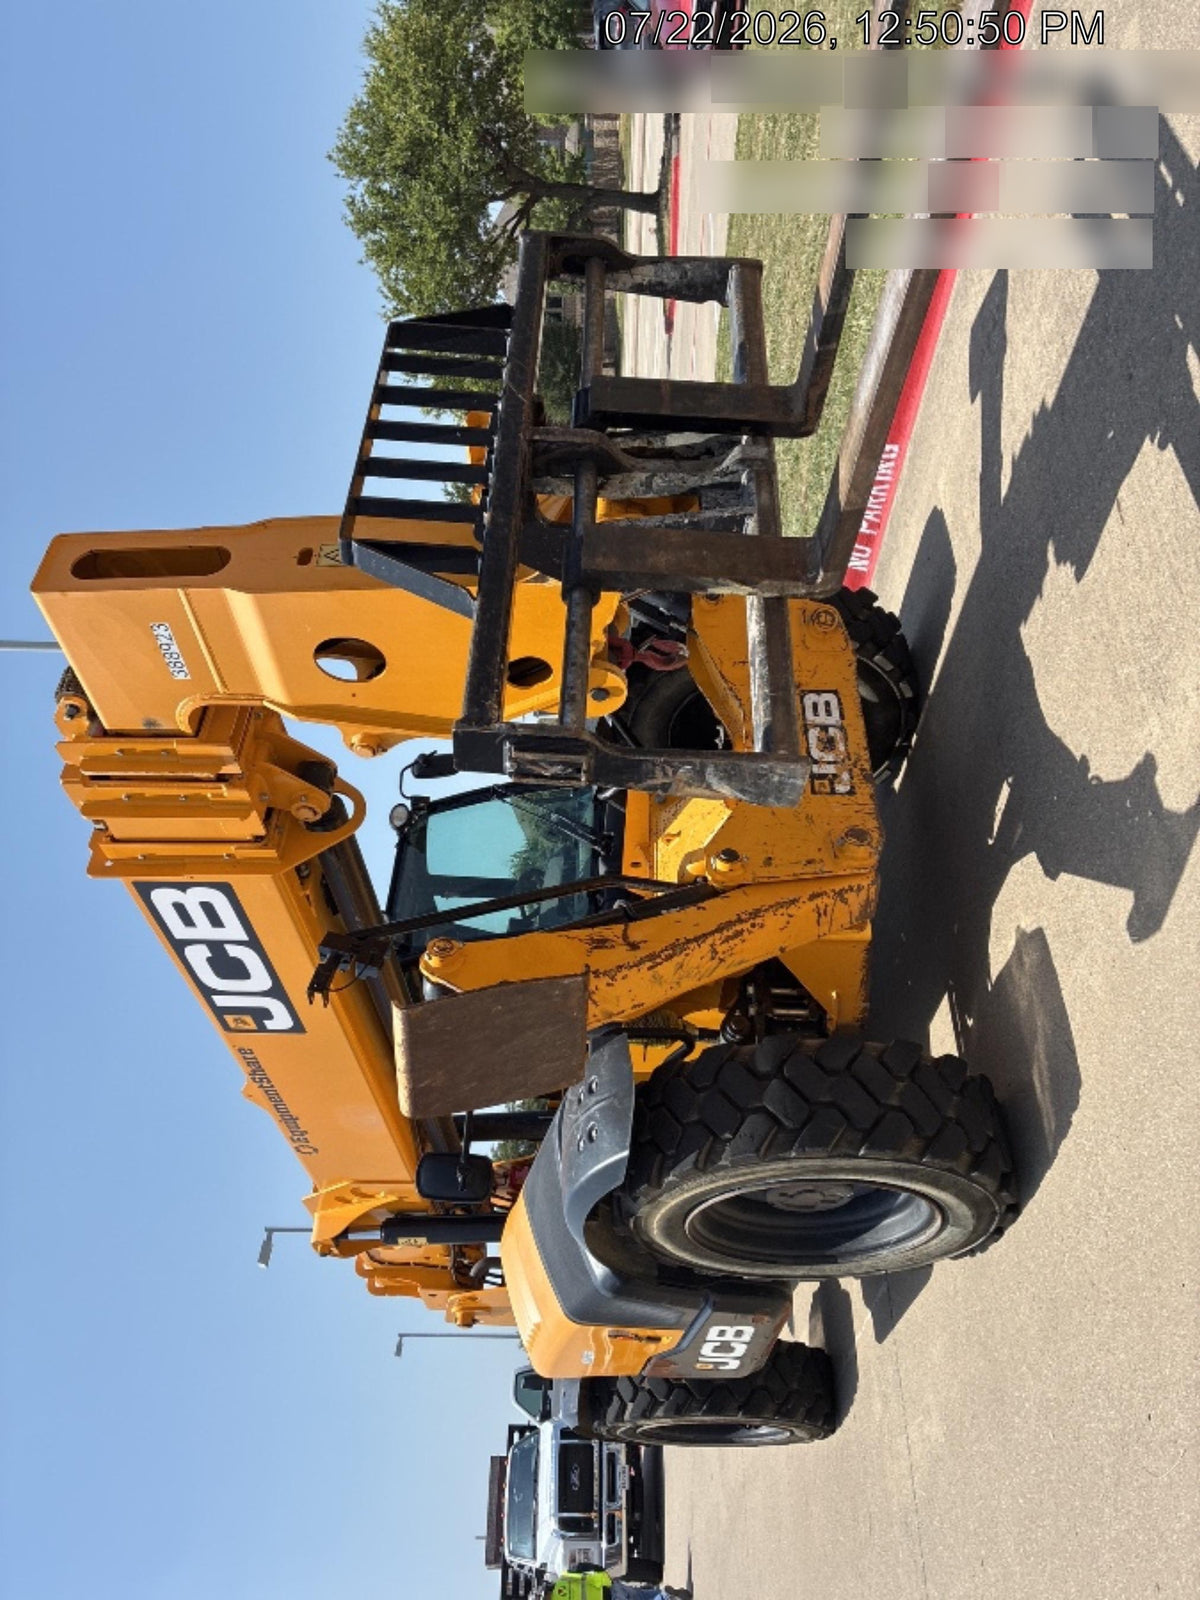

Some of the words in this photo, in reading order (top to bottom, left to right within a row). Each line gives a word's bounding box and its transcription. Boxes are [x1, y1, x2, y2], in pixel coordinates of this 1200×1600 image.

[848, 544, 872, 572] NO
[803, 692, 851, 794] JCB
[150, 886, 294, 1030] JCB
[236, 1046, 309, 1144] EquipmentShare
[698, 1326, 755, 1369] JCB
